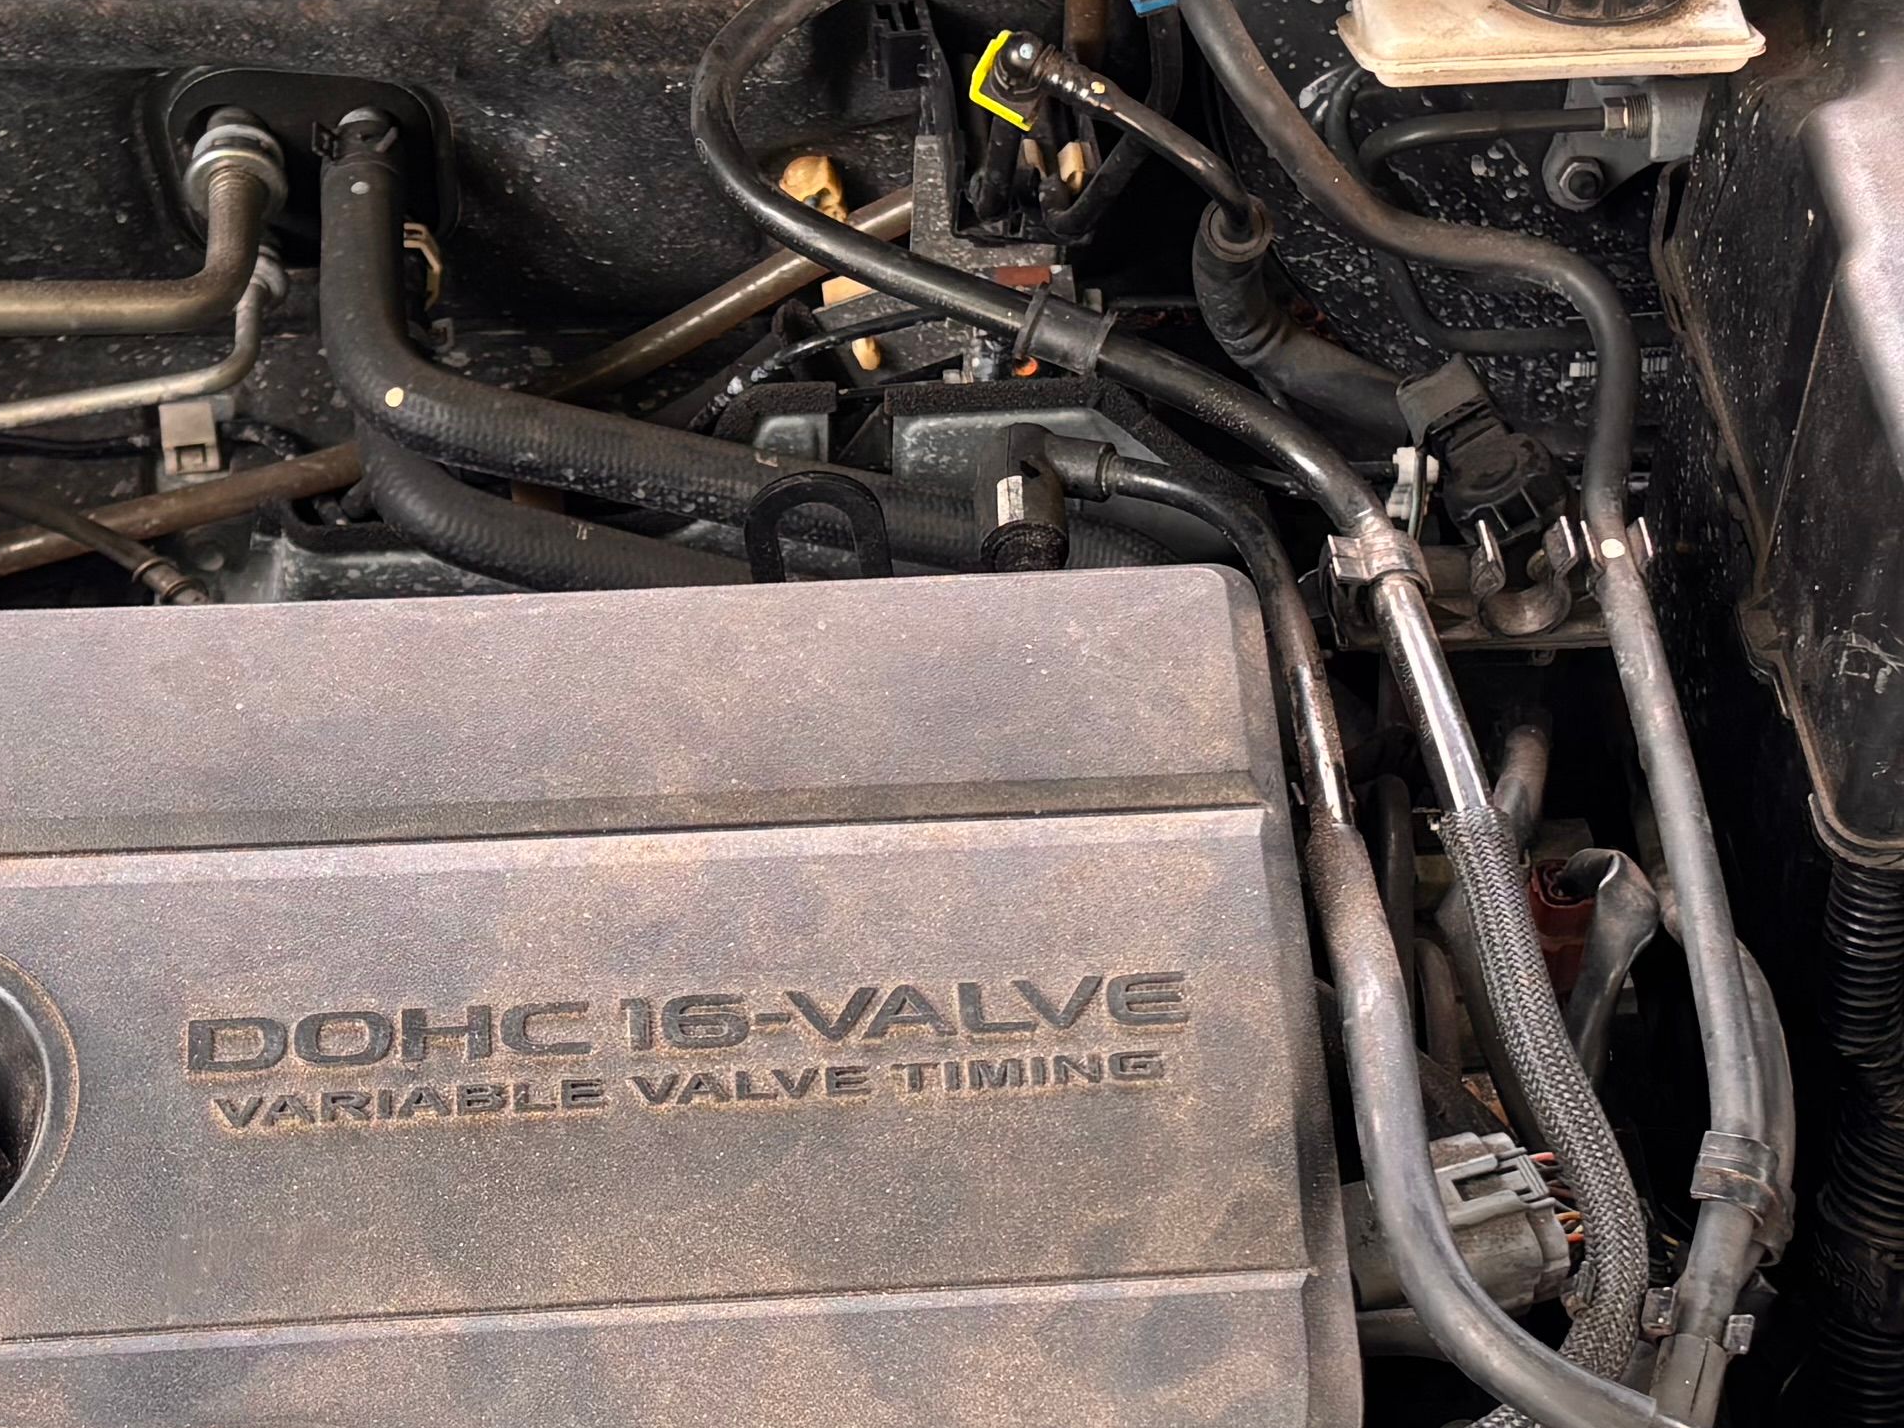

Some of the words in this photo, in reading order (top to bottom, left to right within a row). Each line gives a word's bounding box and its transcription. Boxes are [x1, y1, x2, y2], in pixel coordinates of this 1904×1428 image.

[186, 1000, 596, 1073] DOHC
[619, 972, 1191, 1053] 16-VALVE
[213, 1077, 604, 1129] VARIABLE
[627, 1064, 875, 1105] VALVE
[891, 1049, 1166, 1093] TIMING
